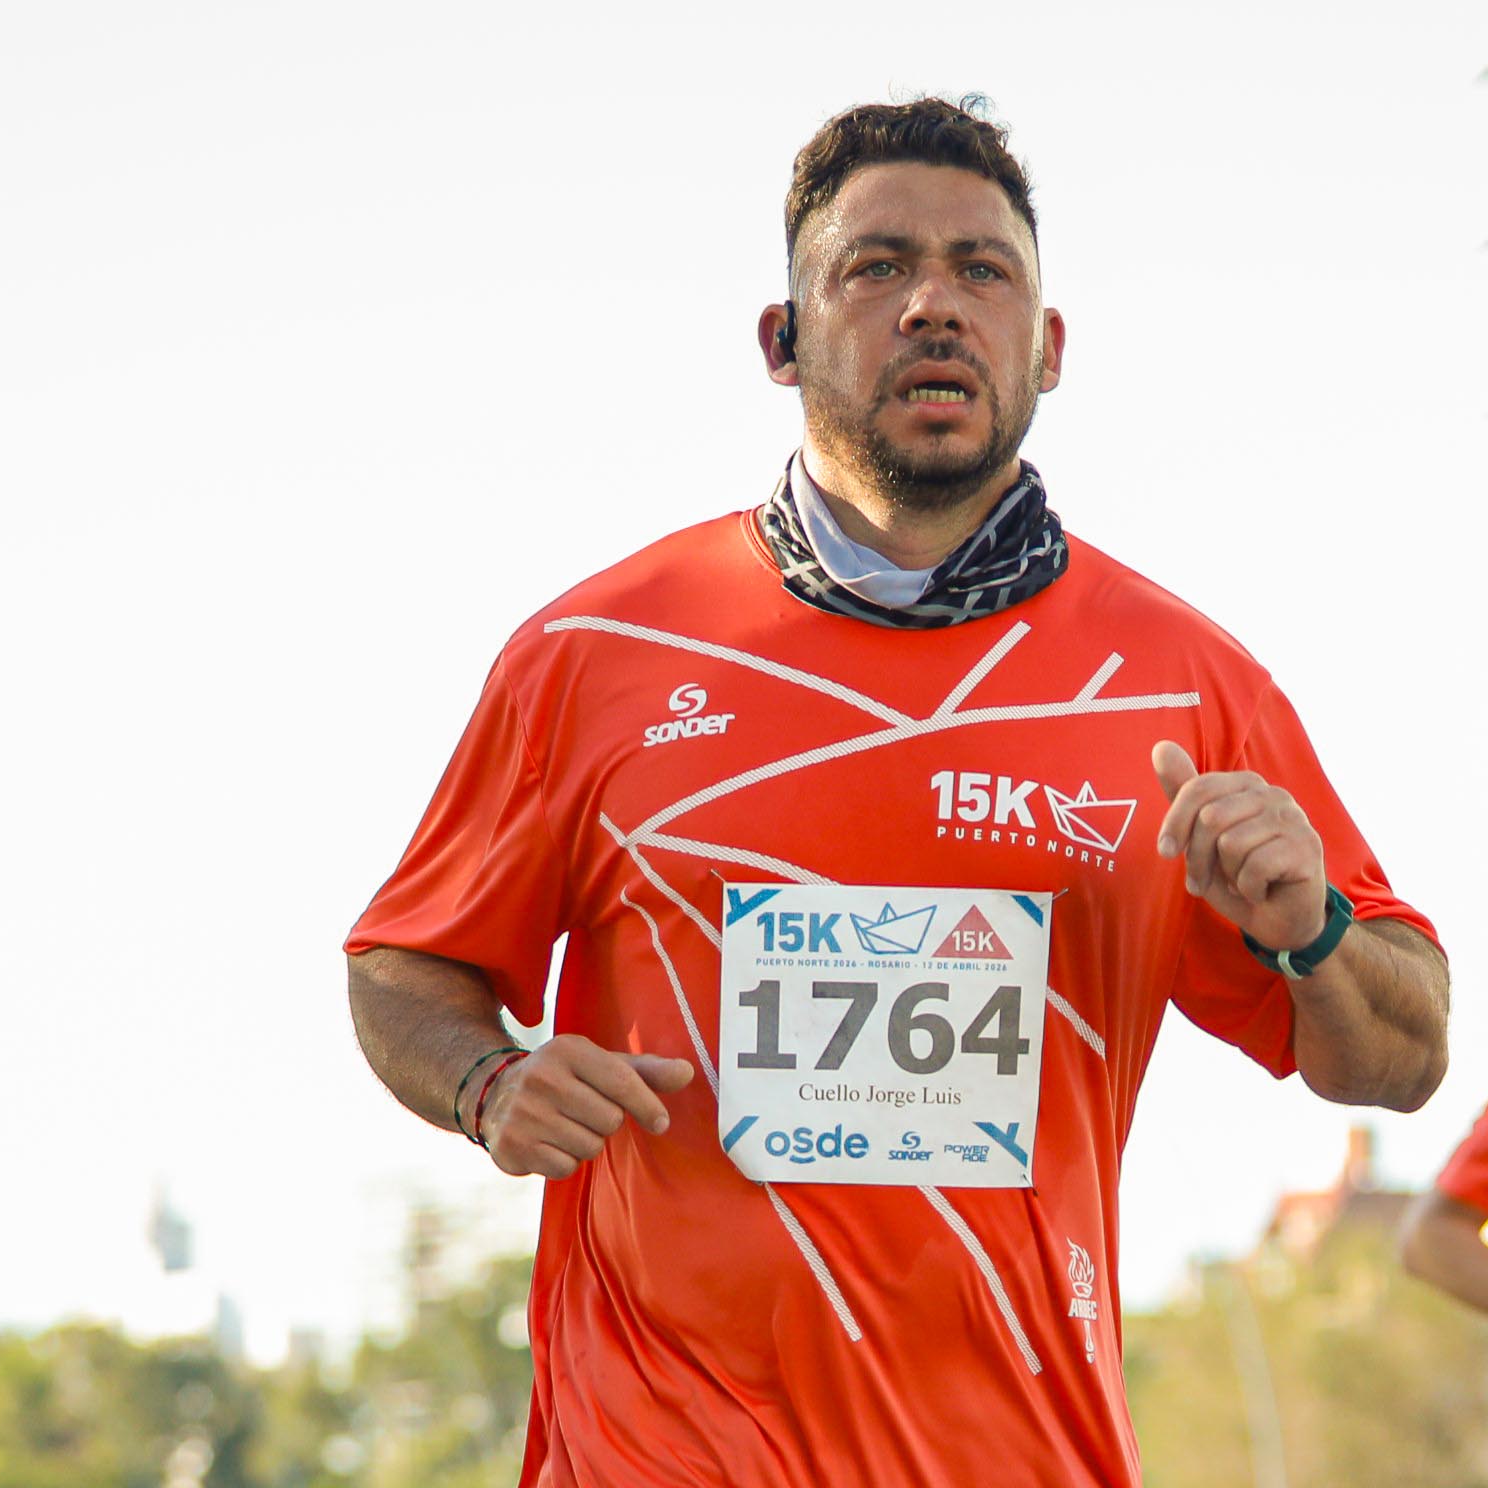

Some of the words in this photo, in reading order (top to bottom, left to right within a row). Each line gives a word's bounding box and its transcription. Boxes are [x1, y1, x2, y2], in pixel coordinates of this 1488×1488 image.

[930, 770, 1040, 829] 15K
[936, 826, 1036, 847] PUERTO
[1047, 839, 1115, 872] NORTE
[757, 911, 843, 953] 15K
[951, 930, 995, 953] 15K
[755, 957, 795, 966] PUERTO
[797, 958, 830, 967] NORTE
[833, 959, 857, 968] 2026
[868, 960, 911, 969] ROSARIO
[922, 961, 933, 969] 12
[937, 961, 949, 970] DE
[952, 962, 981, 971] ABRIL
[984, 963, 1008, 972] 2026
[737, 980, 1030, 1075] 1764
[798, 1083, 861, 1102] Cuello
[866, 1085, 916, 1108] Jorge
[922, 1086, 962, 1105] Luis
[764, 1123, 870, 1162] osde
[944, 1144, 990, 1155] POWER
